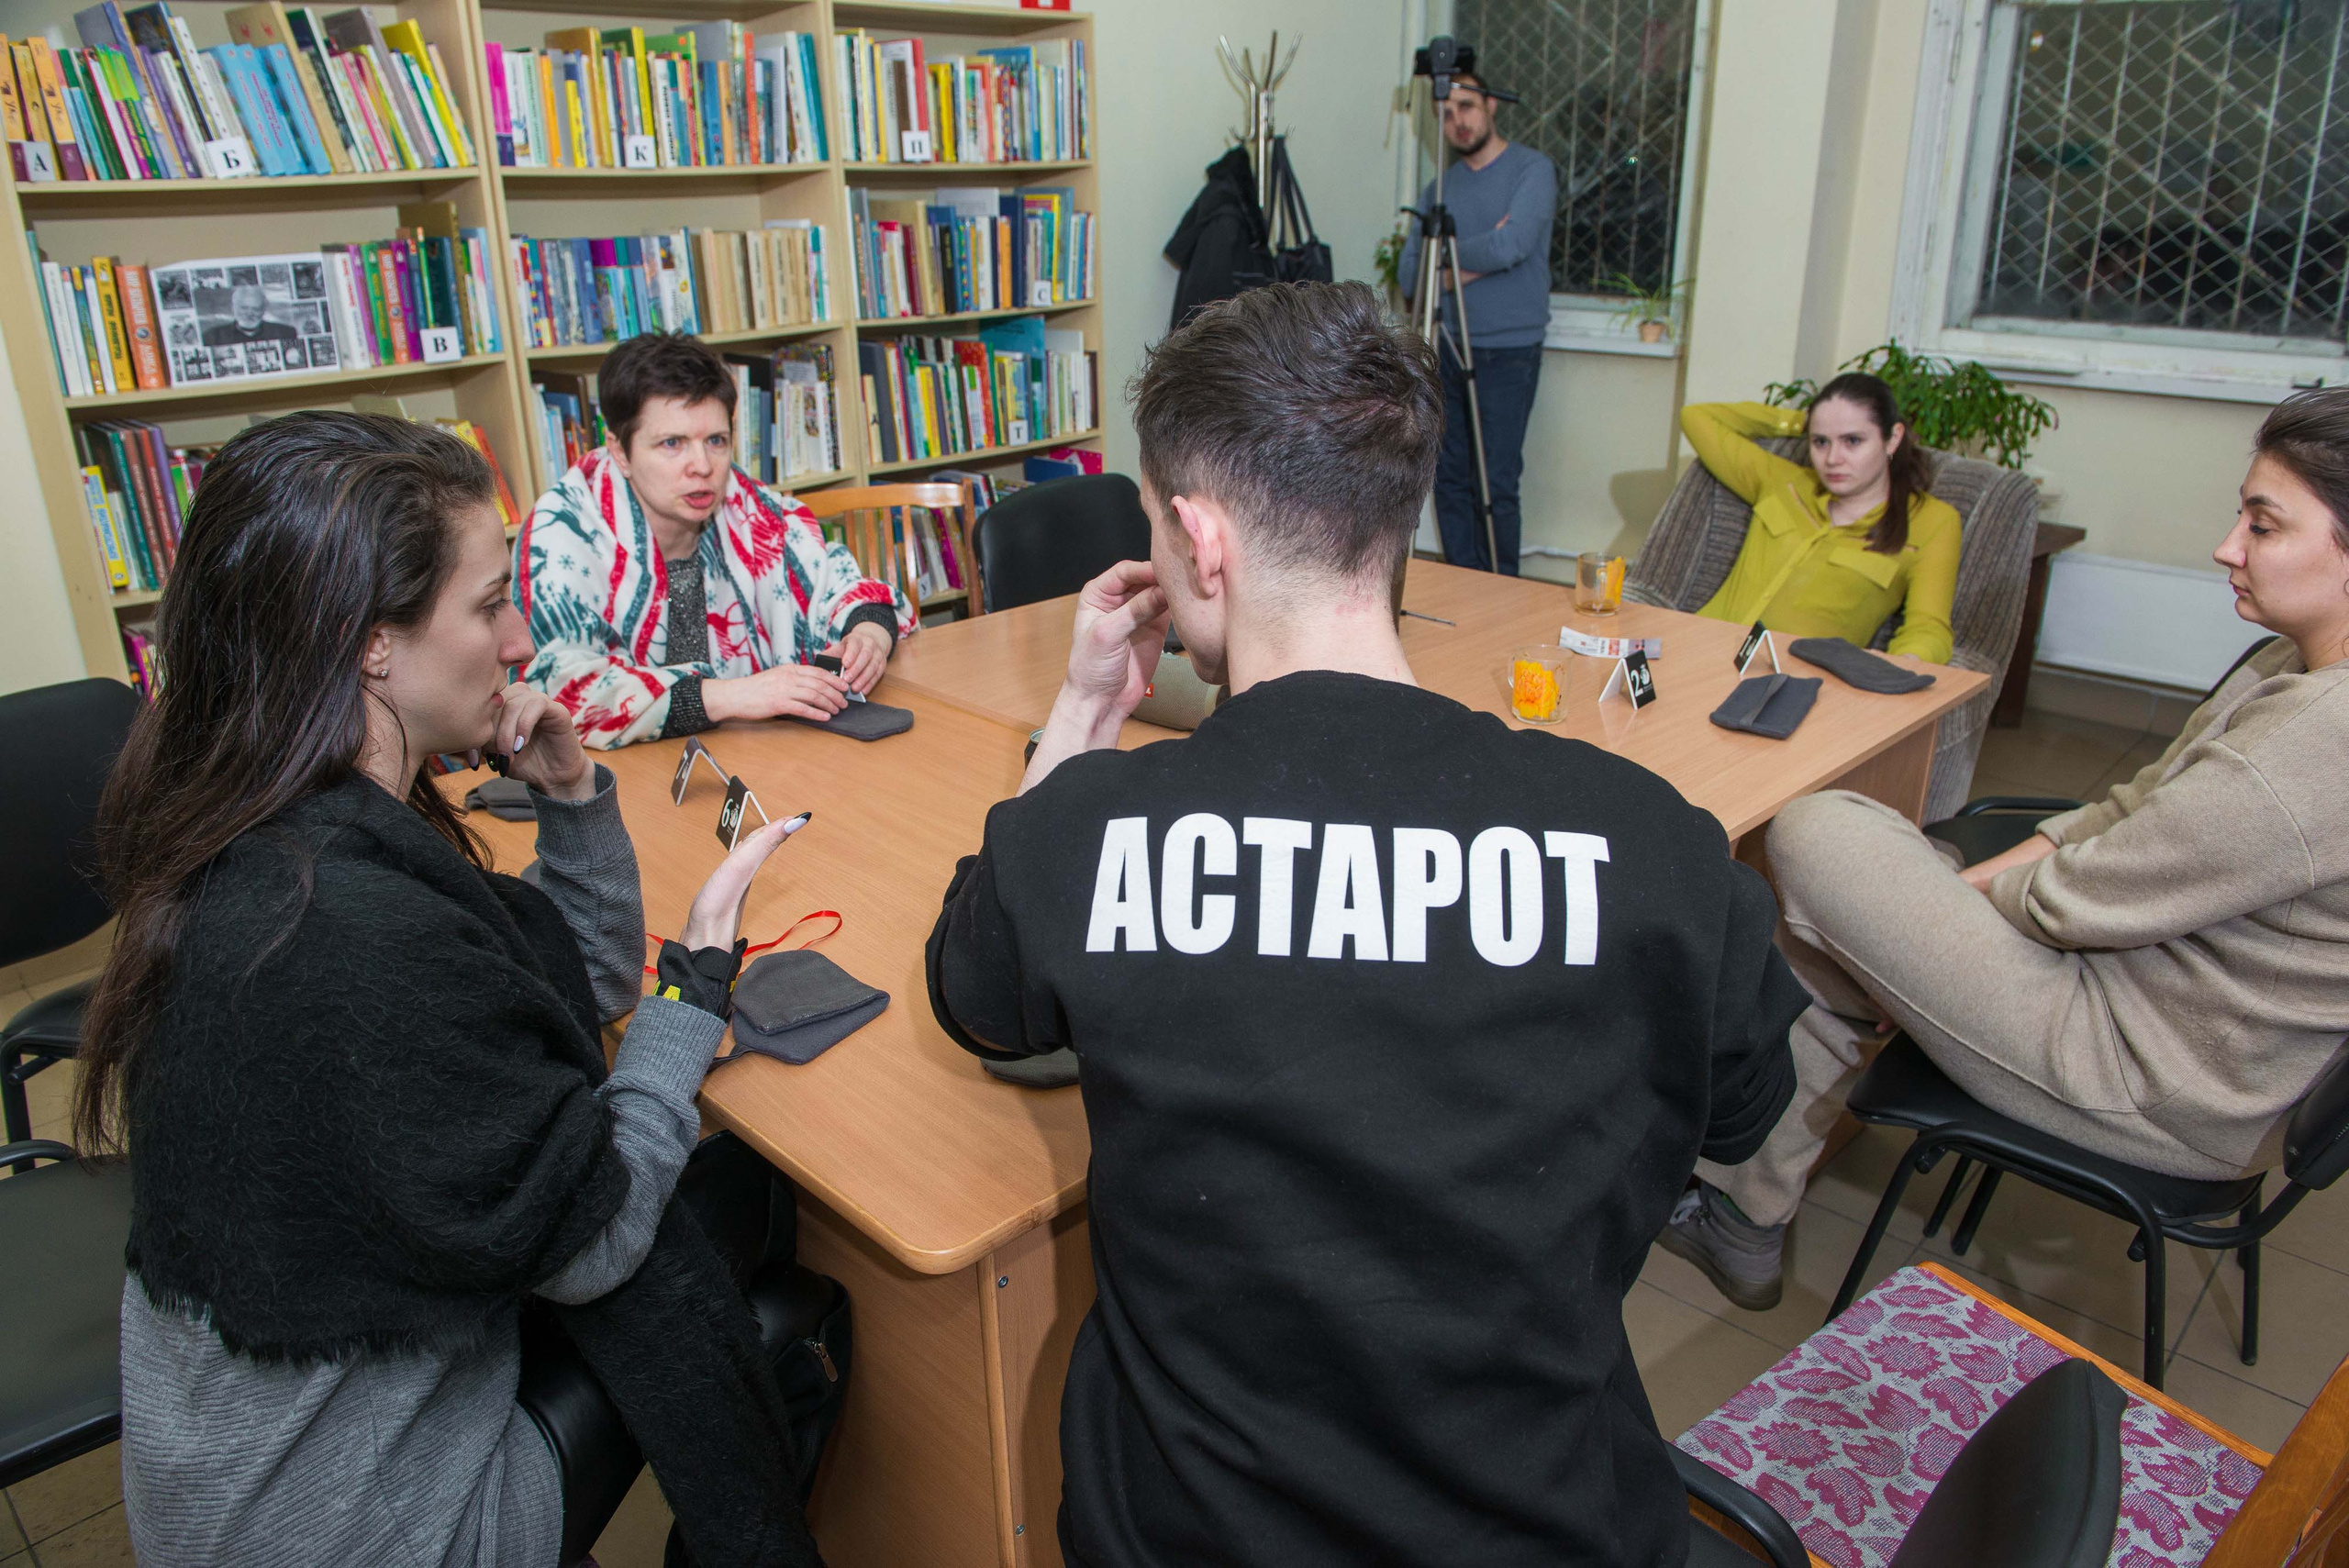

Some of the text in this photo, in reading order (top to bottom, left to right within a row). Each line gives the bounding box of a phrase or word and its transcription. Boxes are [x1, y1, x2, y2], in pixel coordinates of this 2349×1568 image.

[636, 146, 648, 161] К
[911, 140, 923, 154] П
[34, 151, 49, 172] А
[223, 150, 240, 169] Б
[434, 338, 448, 353] В
[1014, 426, 1023, 439] Т
[1739, 635, 1753, 658] 1
[1630, 669, 1644, 697] 2
[675, 750, 689, 780] 7
[721, 798, 734, 828] 6
[1085, 812, 1610, 967] АСТАРОТ
